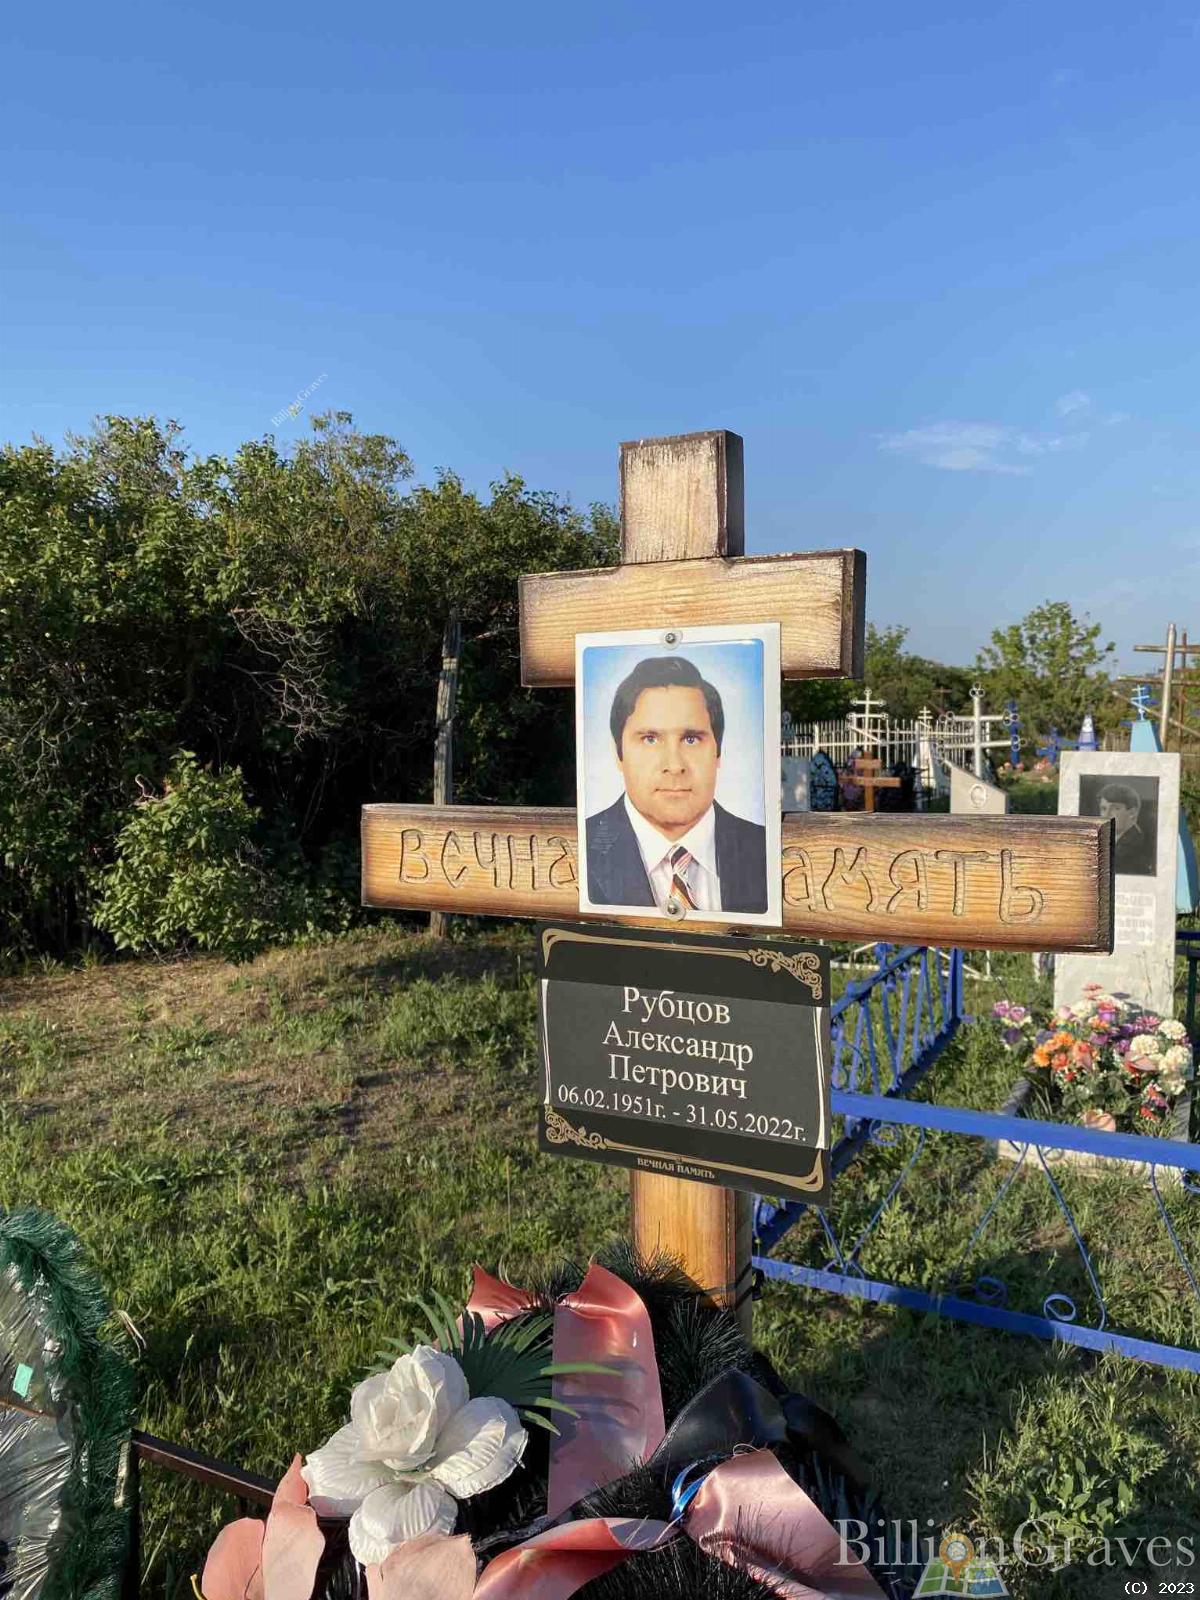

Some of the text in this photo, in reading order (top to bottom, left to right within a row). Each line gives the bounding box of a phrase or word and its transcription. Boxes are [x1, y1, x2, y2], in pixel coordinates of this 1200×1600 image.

[399, 828, 579, 893] ВЕЧНА
[782, 846, 1045, 925] АМЯТЬ
[621, 986, 732, 1026] Рубцов
[602, 1020, 754, 1071] Александр
[608, 1053, 748, 1100] Петрович
[557, 1084, 667, 1119] 06.02.1951г.
[686, 1103, 807, 1142] 31.05.2022г.
